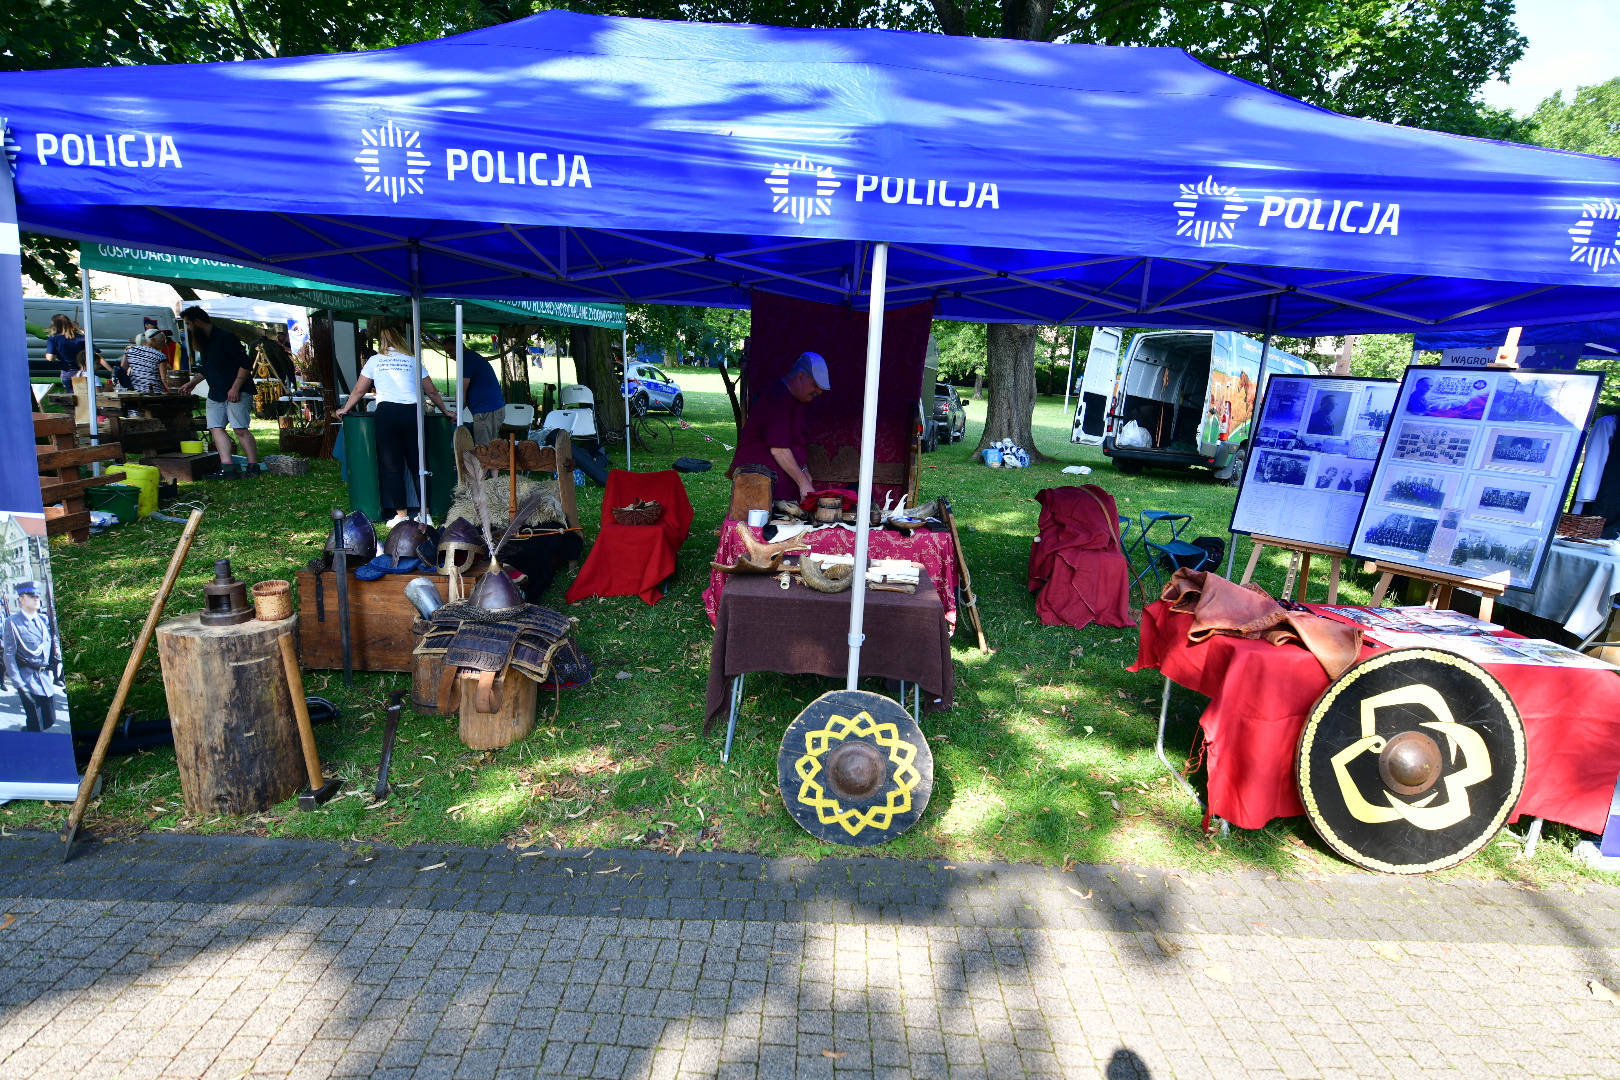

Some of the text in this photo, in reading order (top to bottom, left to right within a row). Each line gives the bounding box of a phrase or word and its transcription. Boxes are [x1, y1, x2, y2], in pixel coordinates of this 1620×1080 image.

[36, 133, 183, 168] POLICJA
[446, 148, 592, 188] POLICJA
[855, 174, 999, 209] POLICJA
[1258, 195, 1400, 235] POLICJA
[1451, 355, 1496, 366] WĄGROW
